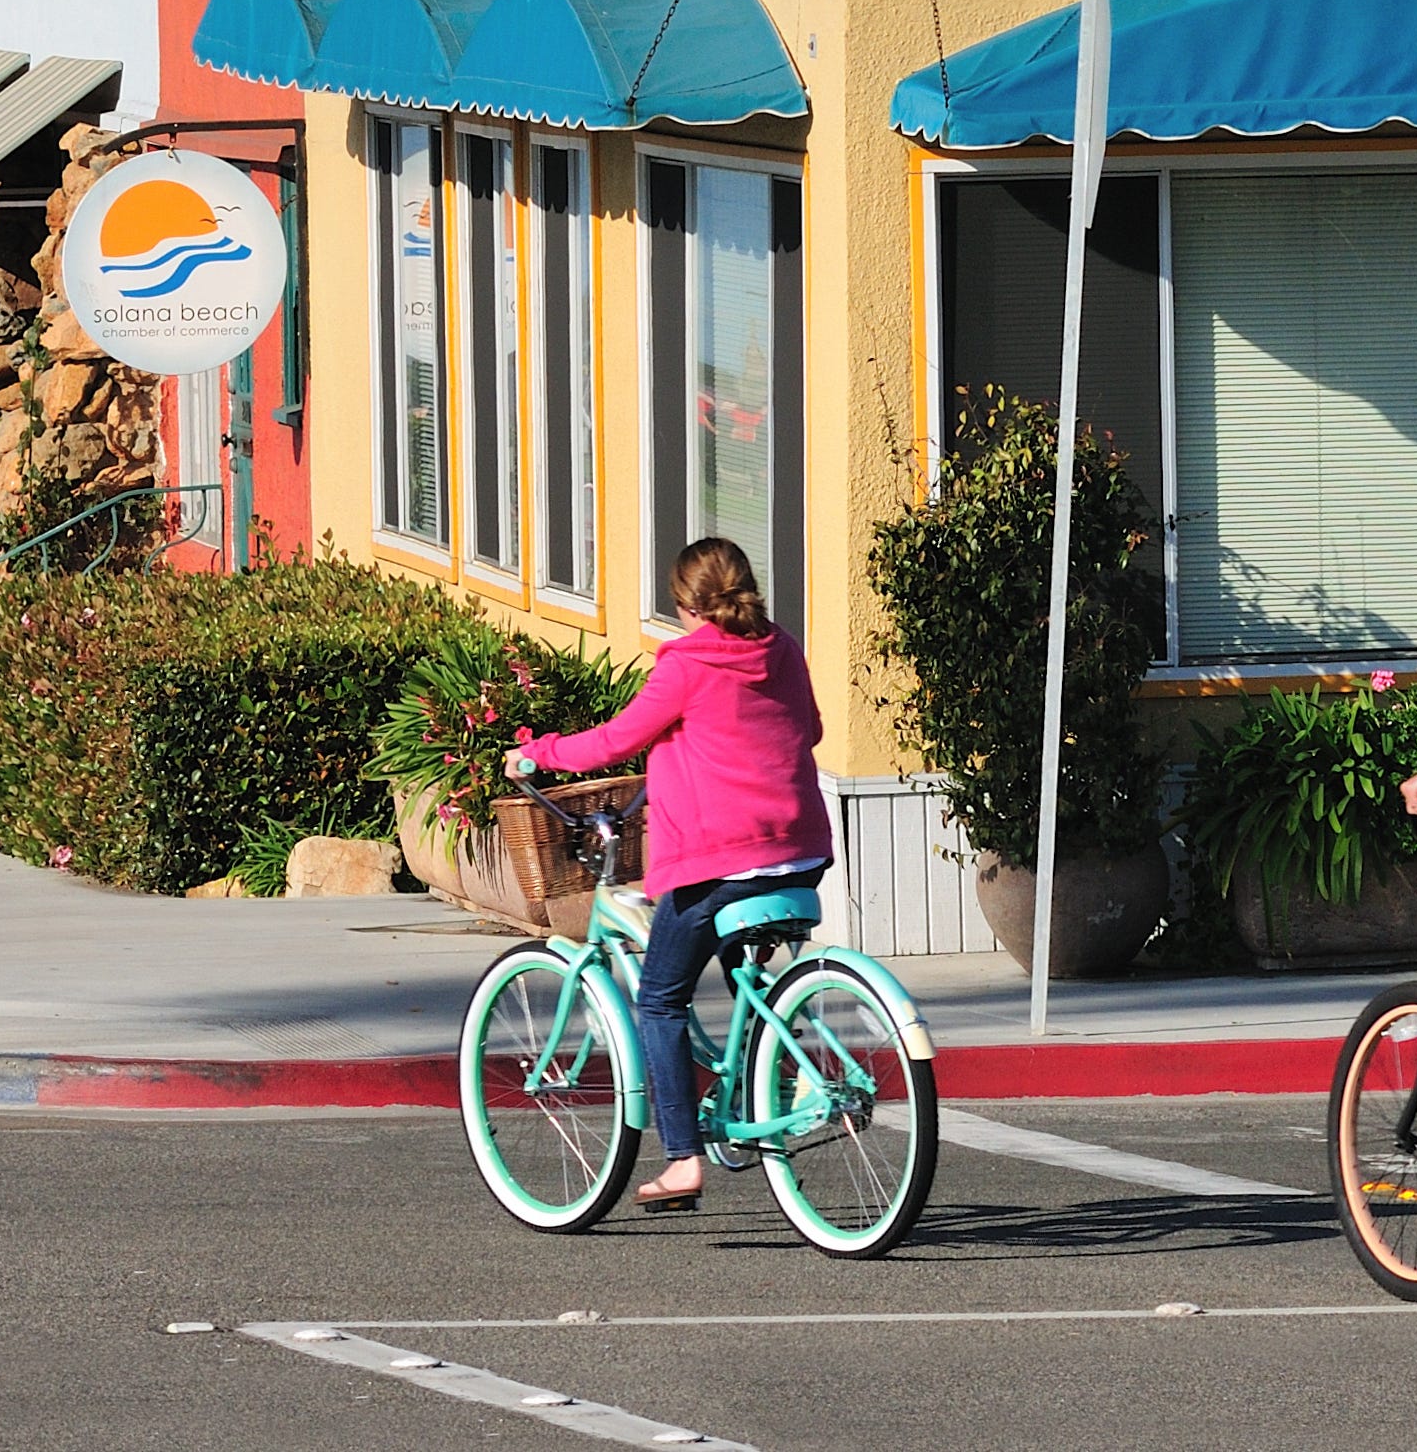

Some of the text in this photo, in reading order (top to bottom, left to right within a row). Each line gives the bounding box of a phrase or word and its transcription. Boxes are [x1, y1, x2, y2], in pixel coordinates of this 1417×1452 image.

[93, 302, 258, 323] solana beach
[102, 326, 249, 338] chamber of commerce
